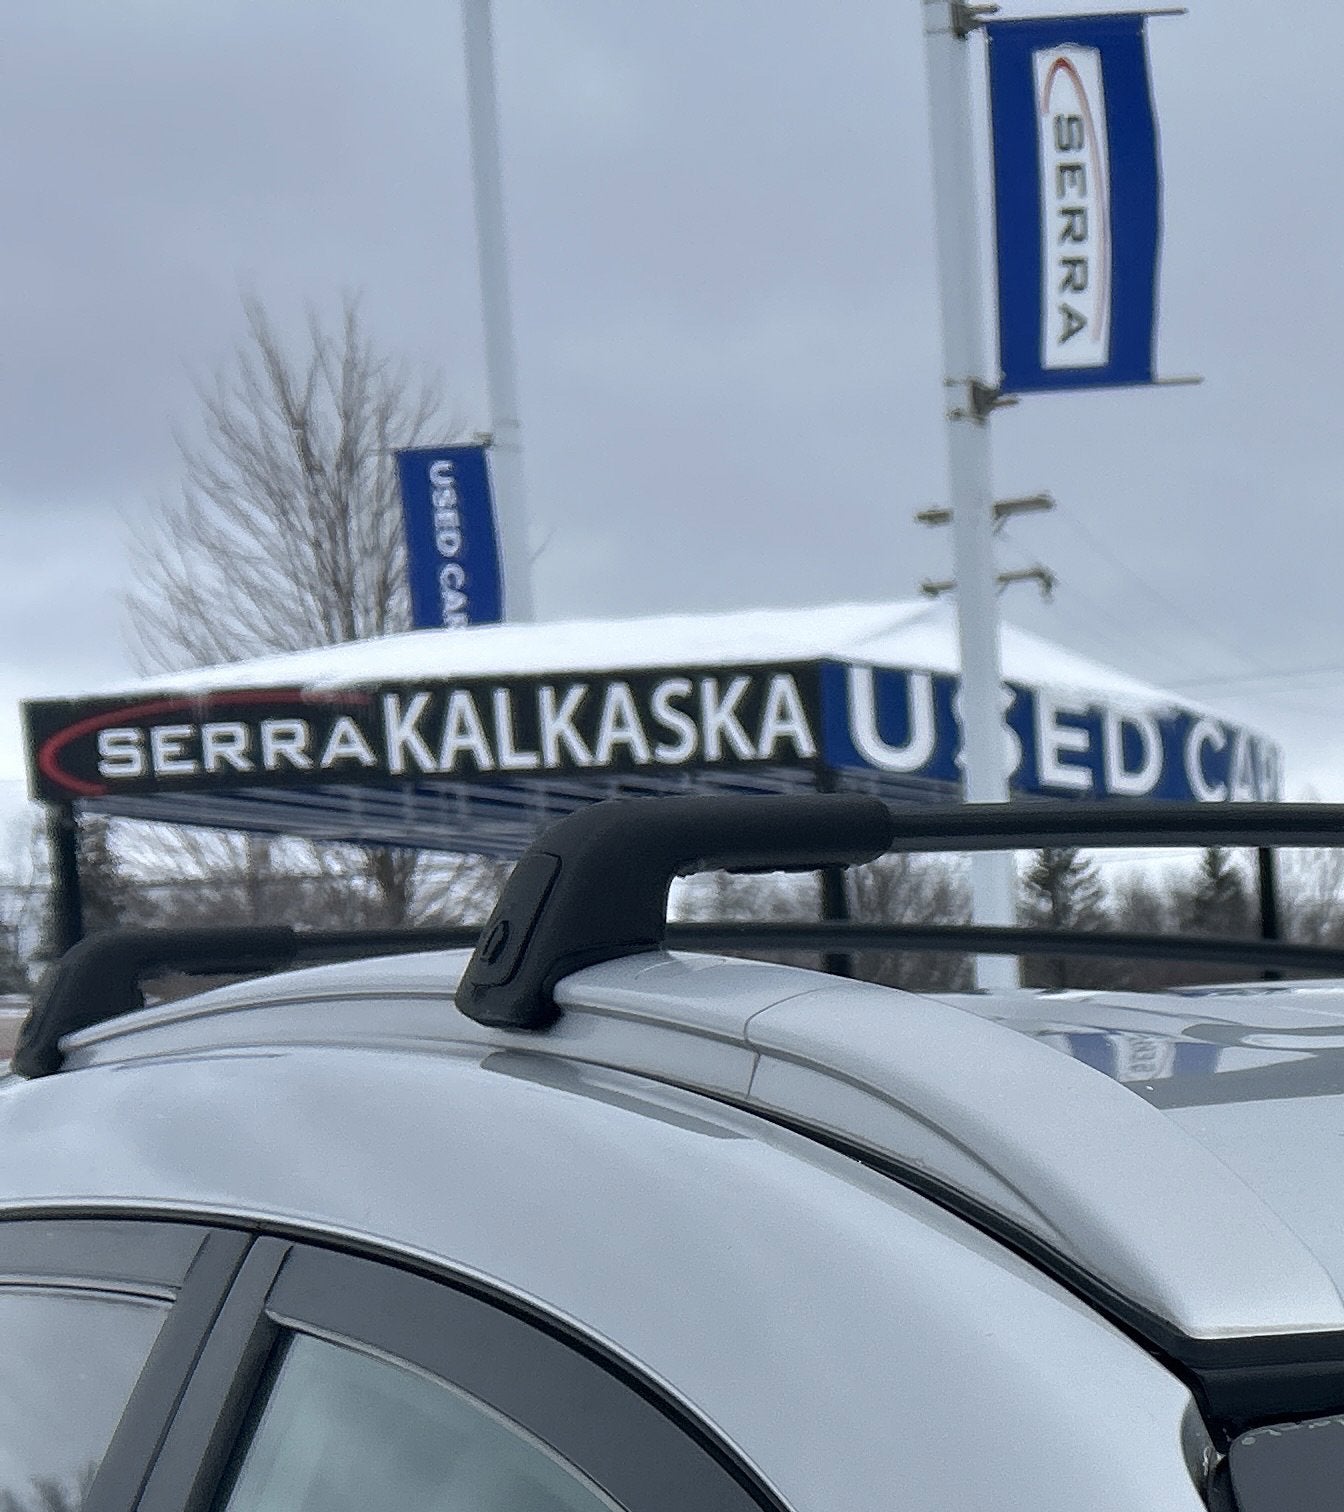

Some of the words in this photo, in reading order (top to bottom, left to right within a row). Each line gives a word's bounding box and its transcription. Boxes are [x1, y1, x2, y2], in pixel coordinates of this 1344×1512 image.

[1053, 113, 1089, 345] SERRA
[429, 460, 462, 558] USED
[97, 715, 376, 779] SERRA
[381, 673, 819, 776] KALKASKA
